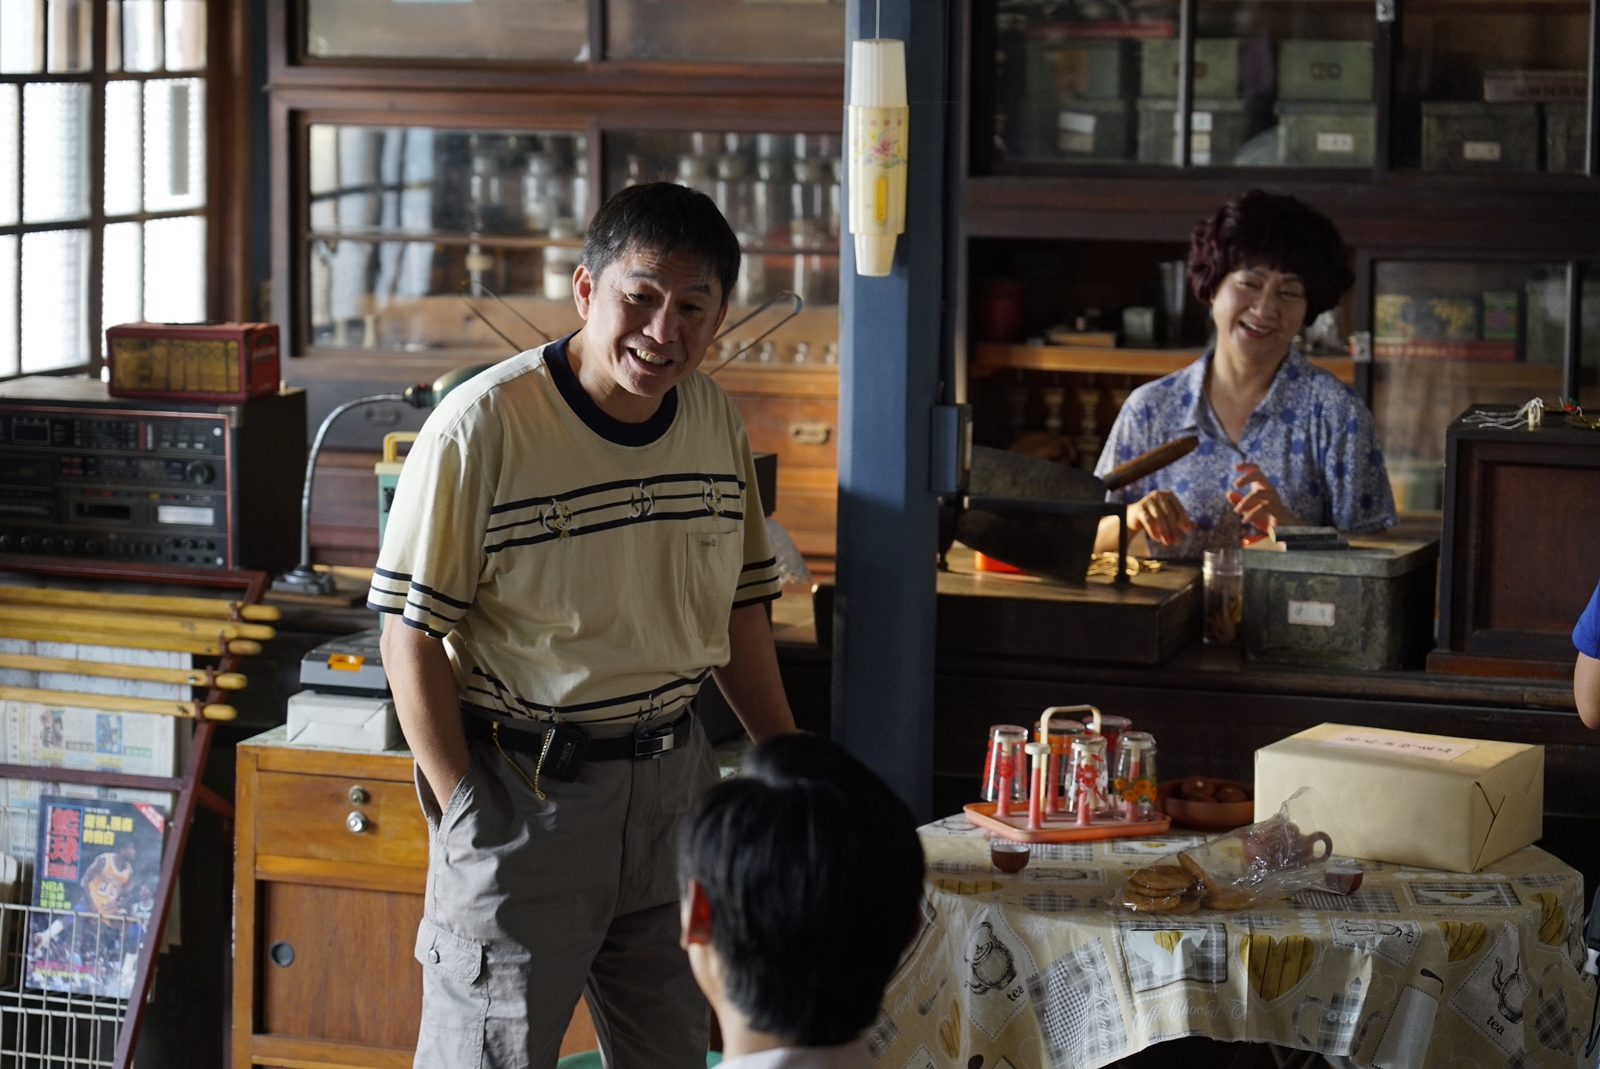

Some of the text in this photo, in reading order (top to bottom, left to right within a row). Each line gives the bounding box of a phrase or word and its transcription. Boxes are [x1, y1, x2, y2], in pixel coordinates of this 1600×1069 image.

[40, 880, 64, 893] NBA
[1006, 985, 1025, 1002] tea
[1094, 978, 1118, 1054] Kitchen
[1486, 1014, 1505, 1036] tea
